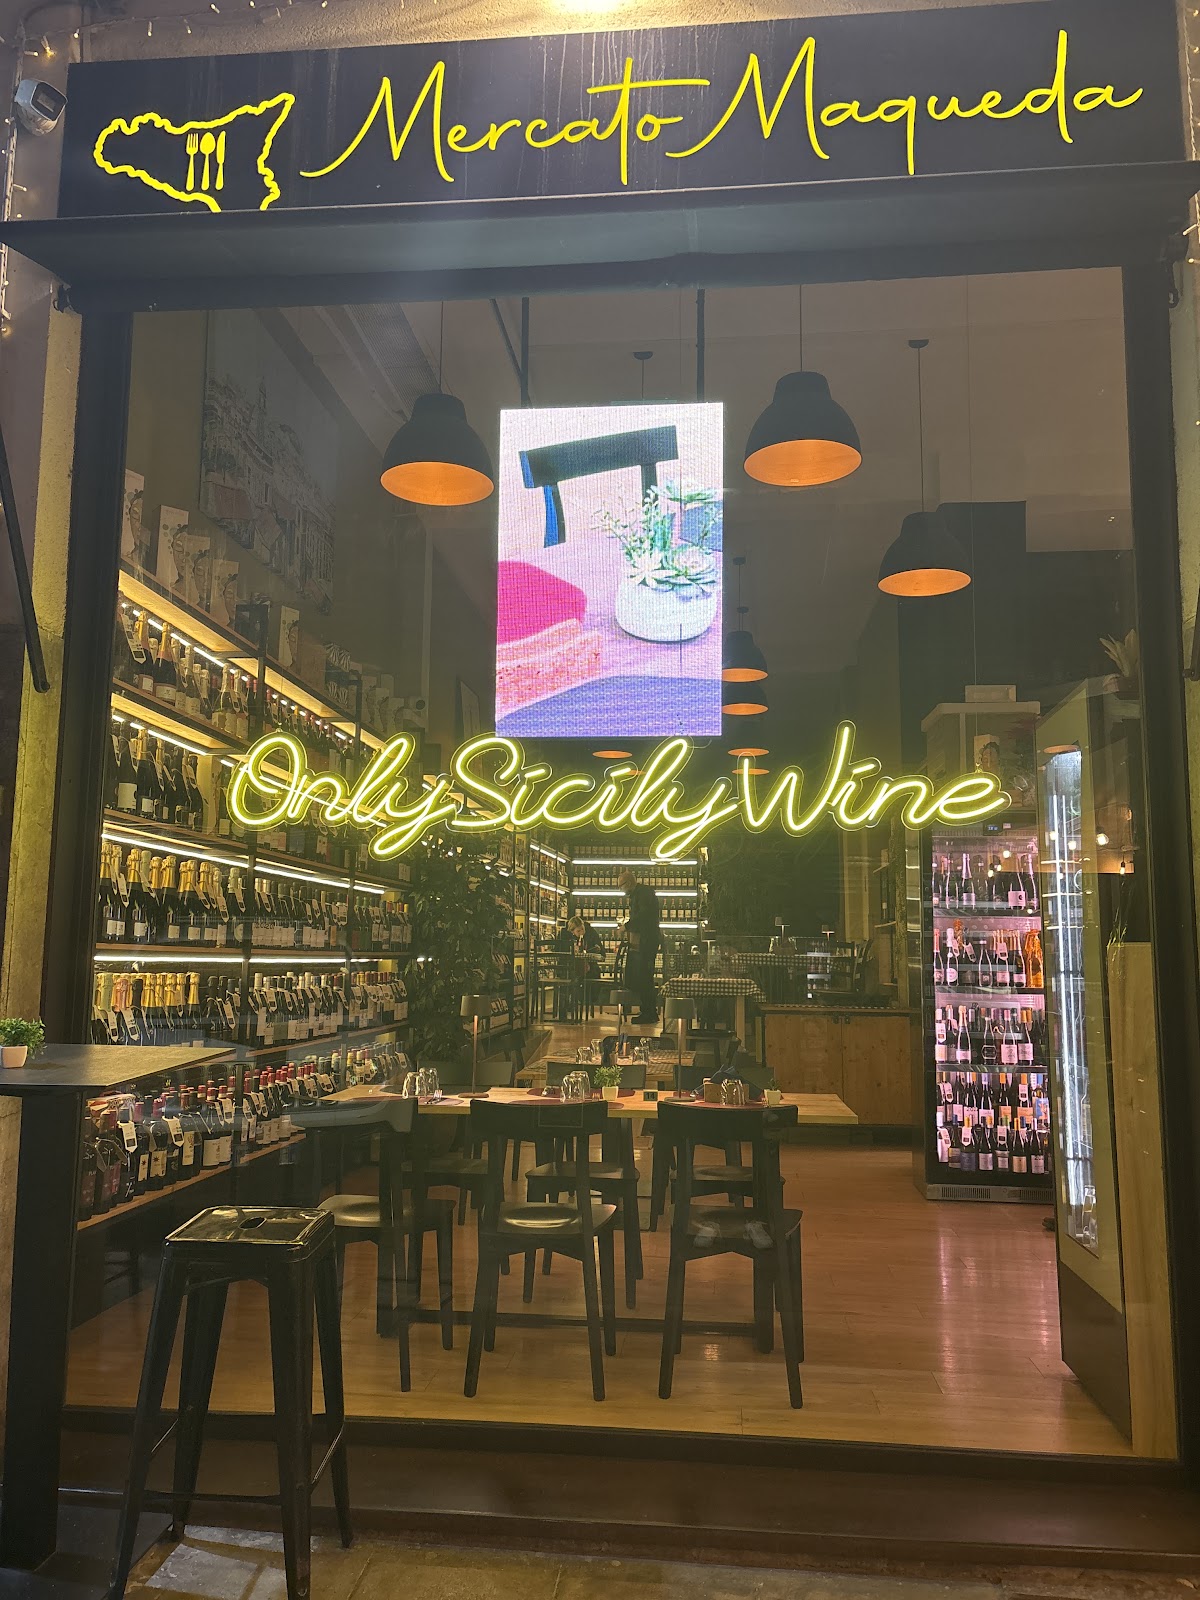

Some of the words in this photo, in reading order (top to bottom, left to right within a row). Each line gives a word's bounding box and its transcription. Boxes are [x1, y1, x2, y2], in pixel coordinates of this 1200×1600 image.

[299, 56, 710, 184] Mercato
[664, 29, 1144, 176] Maqueda
[231, 733, 457, 858] Only
[451, 736, 741, 861] Sicily
[743, 724, 1008, 833] Wine
